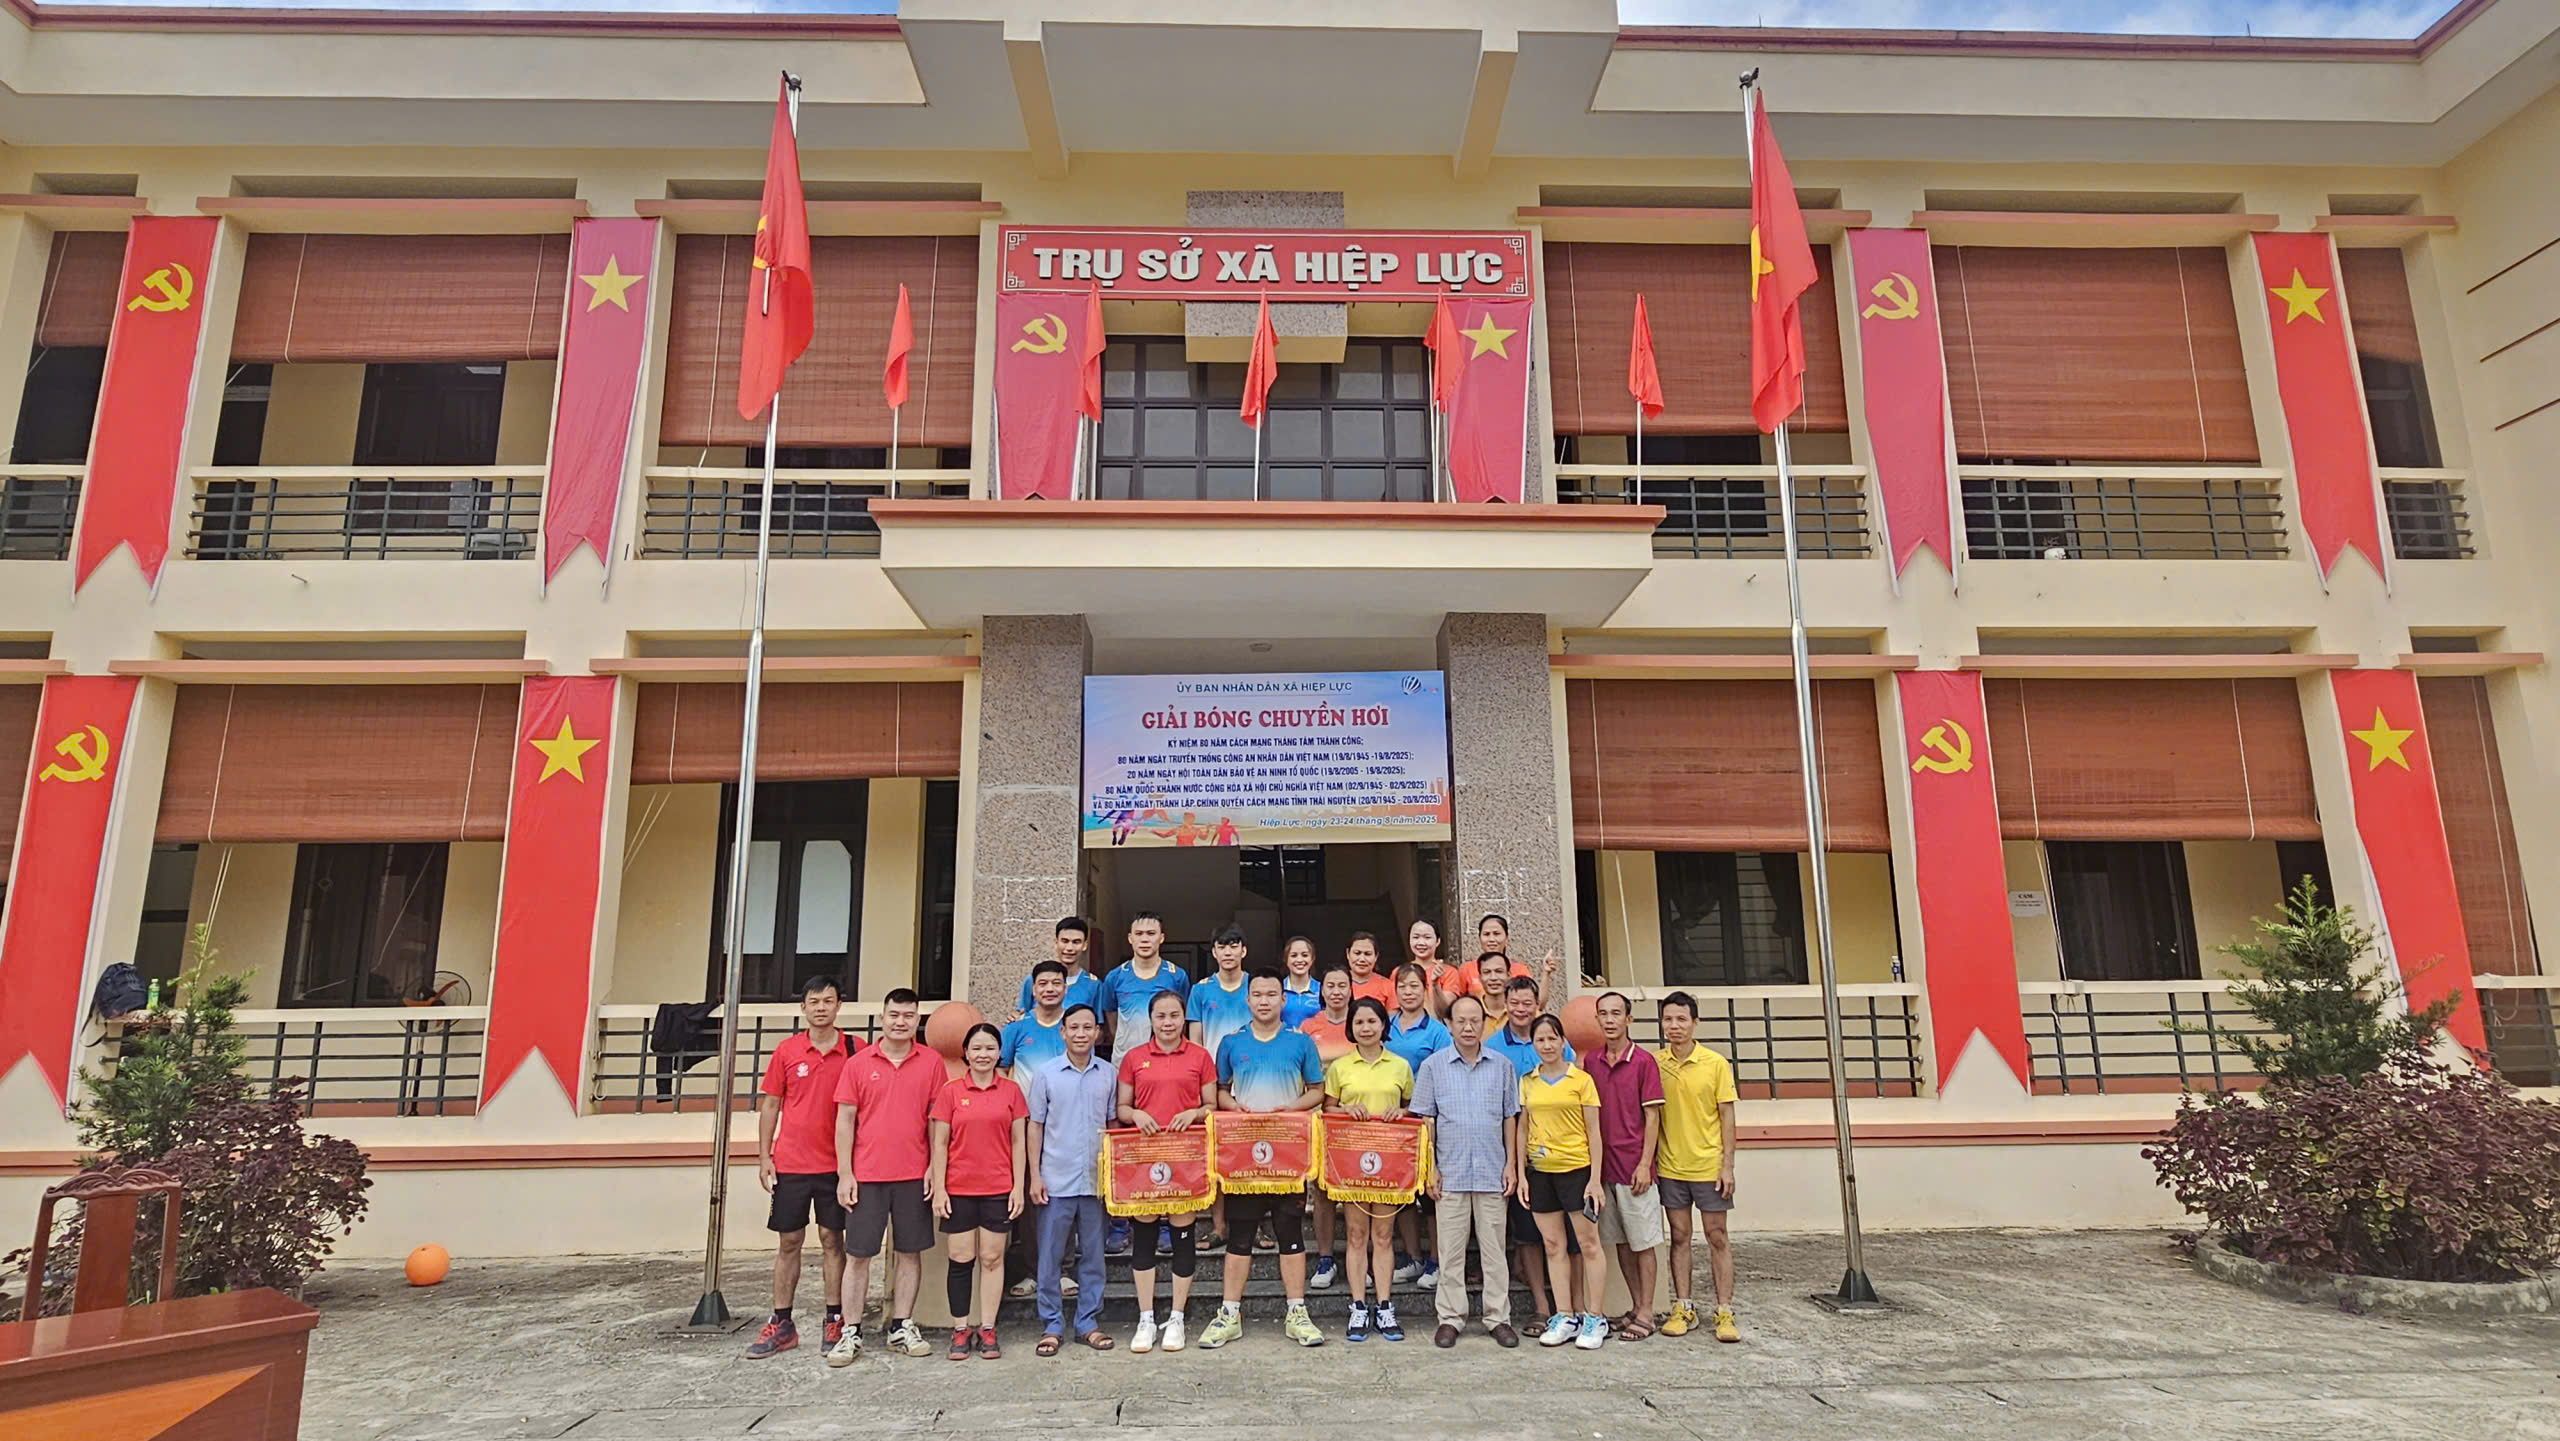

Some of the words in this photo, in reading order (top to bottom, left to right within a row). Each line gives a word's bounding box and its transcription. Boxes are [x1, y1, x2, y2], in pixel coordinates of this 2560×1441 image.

[1033, 247, 1122, 286] TRỤ
[1137, 237, 1205, 282] SỞ
[1216, 244, 1281, 283] XÃ
[1293, 244, 1399, 291] HIỆP
[1415, 249, 1504, 292] LỰC
[1176, 681, 1192, 693] ỦY
[1195, 683, 1219, 693] BAN
[1222, 681, 1253, 693] NHÂN
[1257, 681, 1280, 692] DÂN
[1283, 681, 1298, 691] XÃ
[1301, 681, 1326, 693] HIỆP
[1329, 682, 1352, 692] LỰC
[1141, 704, 1187, 729] GIẢI
[1193, 706, 1252, 728] BÓNG
[1258, 701, 1345, 727] CHUYỀN
[1351, 705, 1389, 726] HƠI
